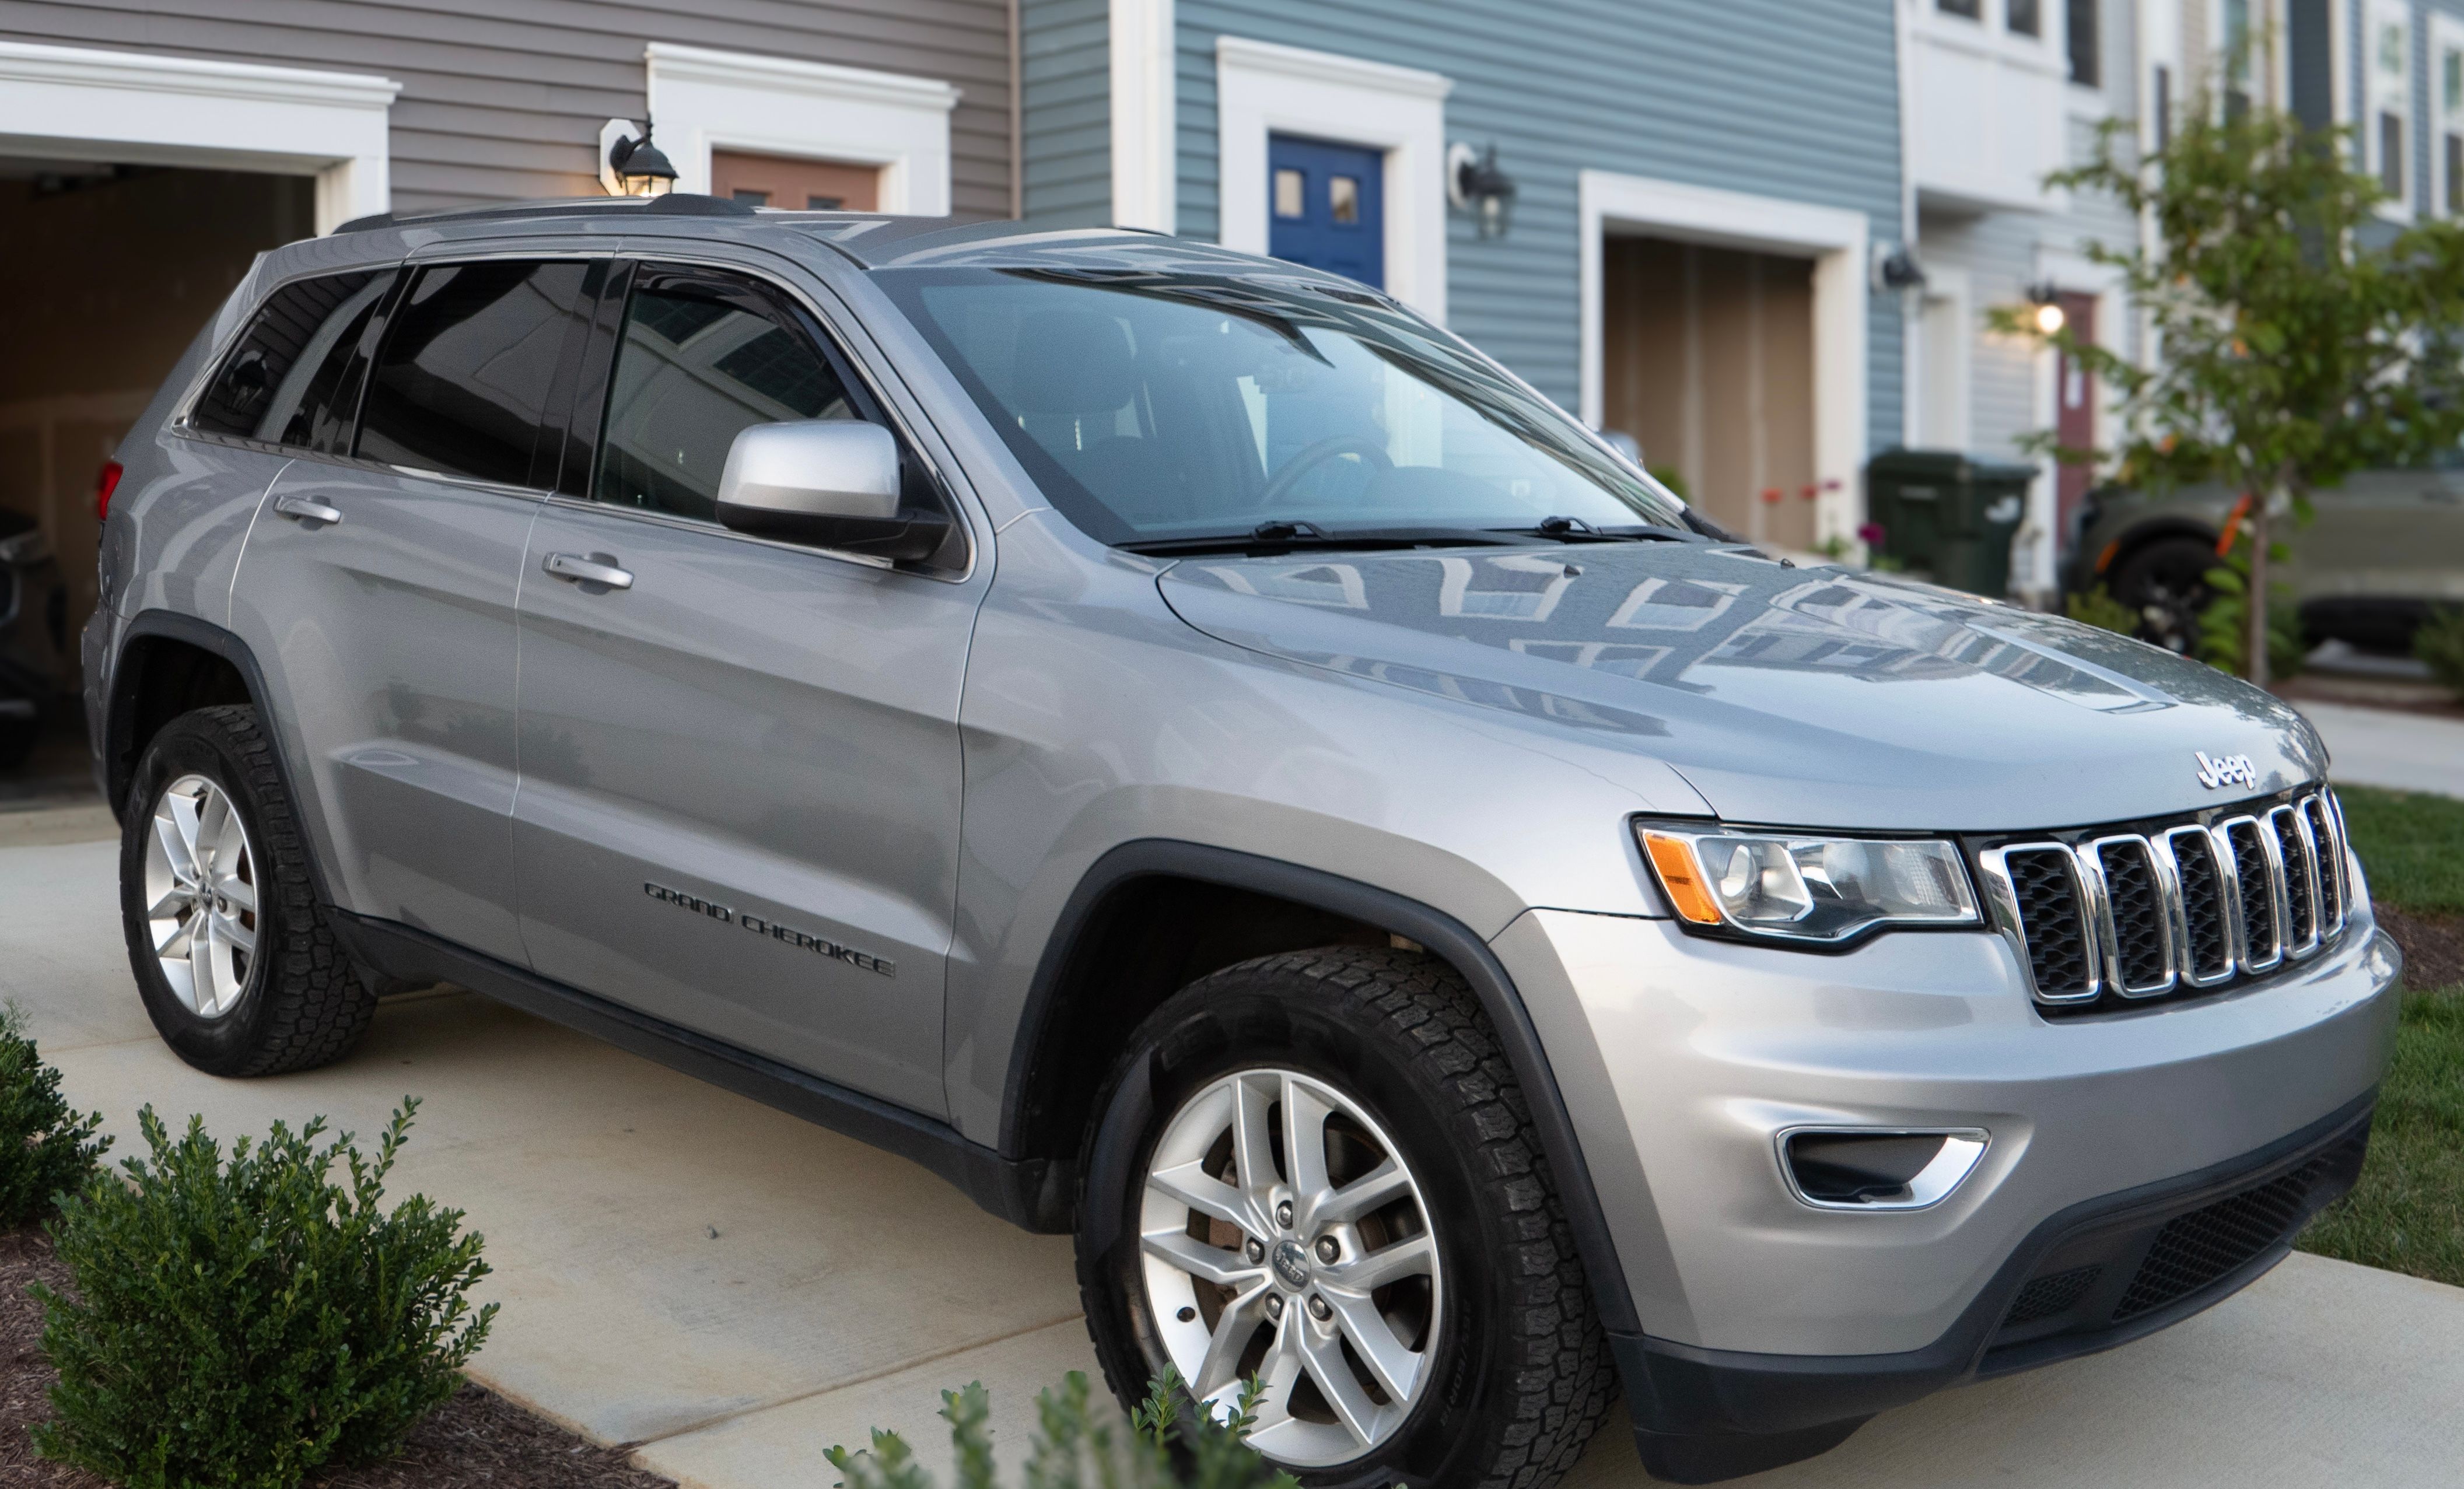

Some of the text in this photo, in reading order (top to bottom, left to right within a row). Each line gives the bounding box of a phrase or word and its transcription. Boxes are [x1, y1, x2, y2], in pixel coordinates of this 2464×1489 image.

[2194, 751, 2256, 790] Jeep
[644, 882, 896, 978] GRAND CHEROKEE
